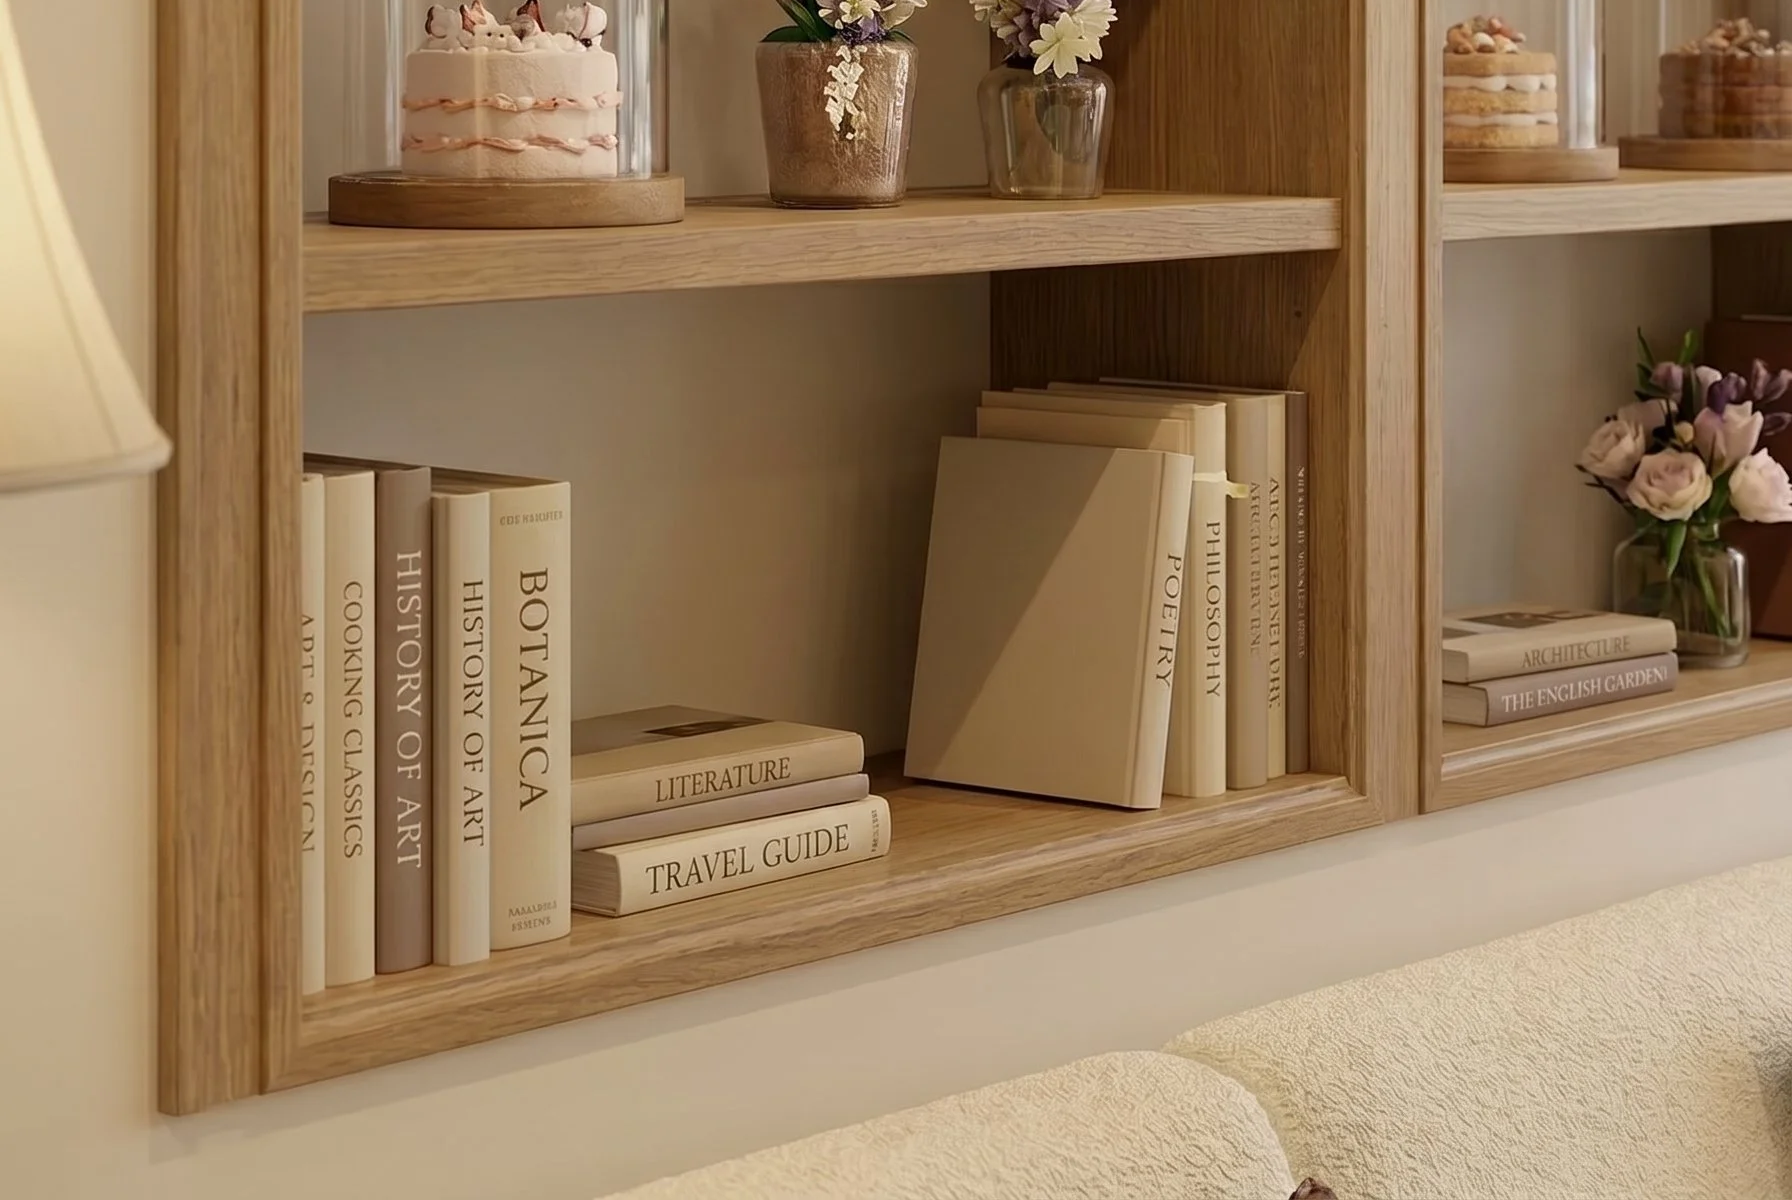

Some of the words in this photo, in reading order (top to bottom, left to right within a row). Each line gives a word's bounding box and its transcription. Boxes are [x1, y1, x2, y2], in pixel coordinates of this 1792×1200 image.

[397, 549, 422, 719] HISTORY
[1155, 552, 1182, 688] POETRY
[1205, 521, 1221, 698] PHILOSOPHY
[342, 580, 363, 719] COOKING
[463, 580, 484, 720] HISTORY
[1522, 635, 1631, 669] ARCHITECTURE
[519, 567, 549, 812] BOTANICA
[1501, 691, 1533, 713] THE
[1537, 677, 1601, 707] ENGLISH
[396, 730, 422, 780] OF
[463, 731, 484, 774] OF
[655, 756, 791, 803] LITERATURE
[342, 729, 363, 860] CLASSICS
[463, 785, 485, 847] ART
[396, 795, 422, 868] ART
[646, 845, 754, 895] TRAVEL
[762, 823, 850, 868] GUIDE
